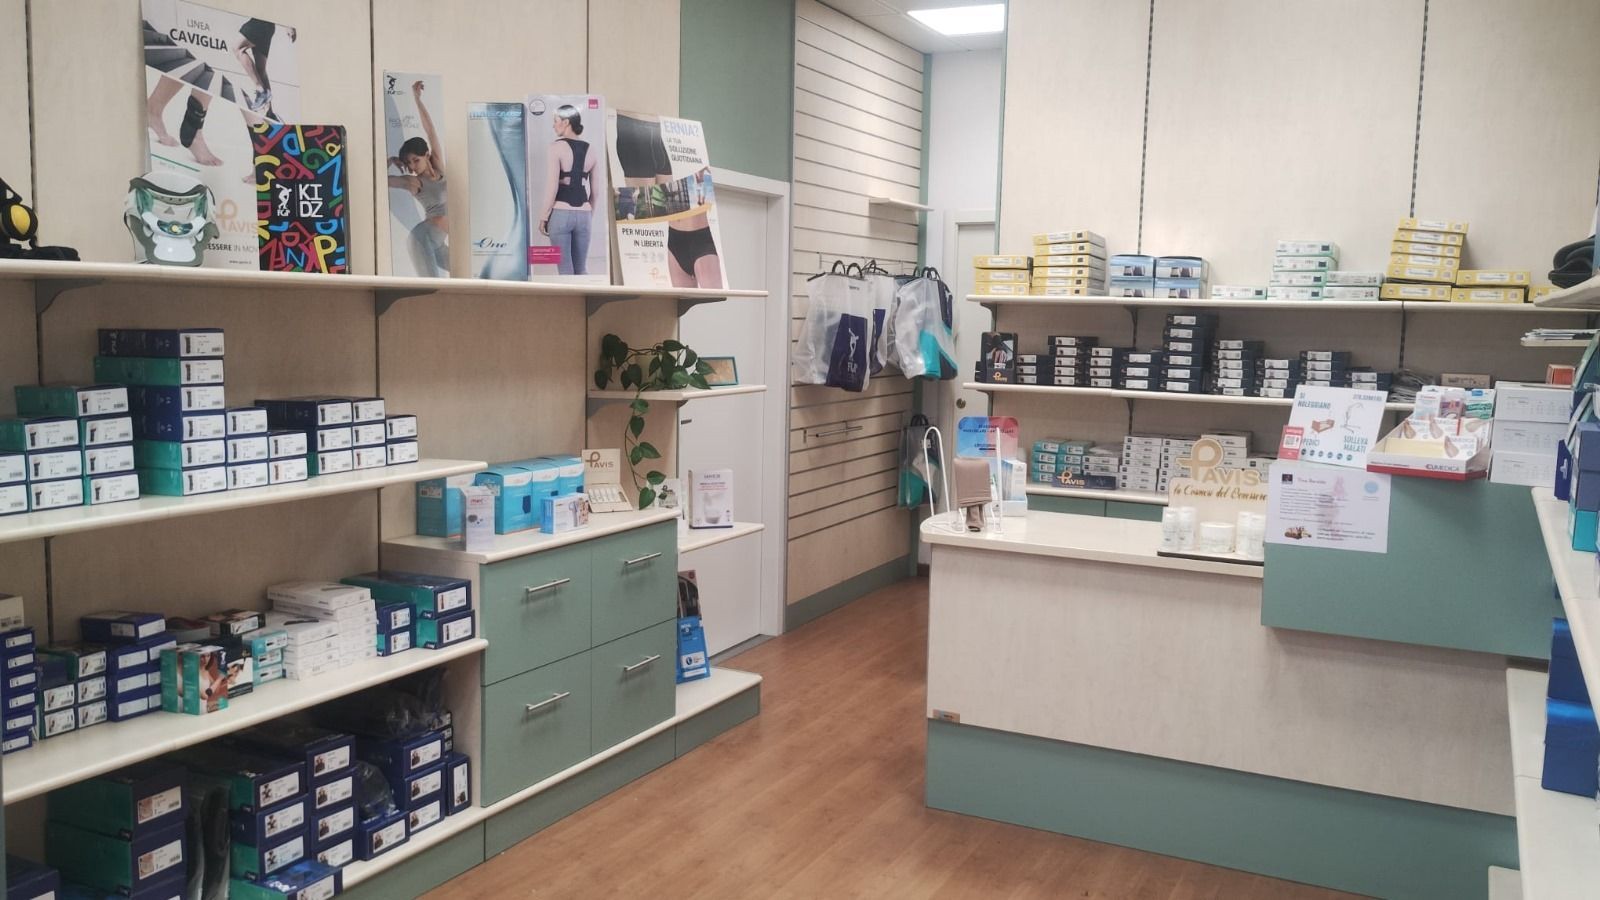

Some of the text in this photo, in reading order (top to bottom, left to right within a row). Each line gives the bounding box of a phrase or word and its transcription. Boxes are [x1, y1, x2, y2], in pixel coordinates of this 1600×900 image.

[187, 19, 210, 31] LINEA
[169, 28, 228, 52] CAVIGLIA
[622, 228, 665, 238] PER MUOVERTI
[207, 243, 232, 251] ESSERE
[1297, 400, 1331, 410] NOLEGGIANO
[1175, 438, 1260, 487] PAVIS
